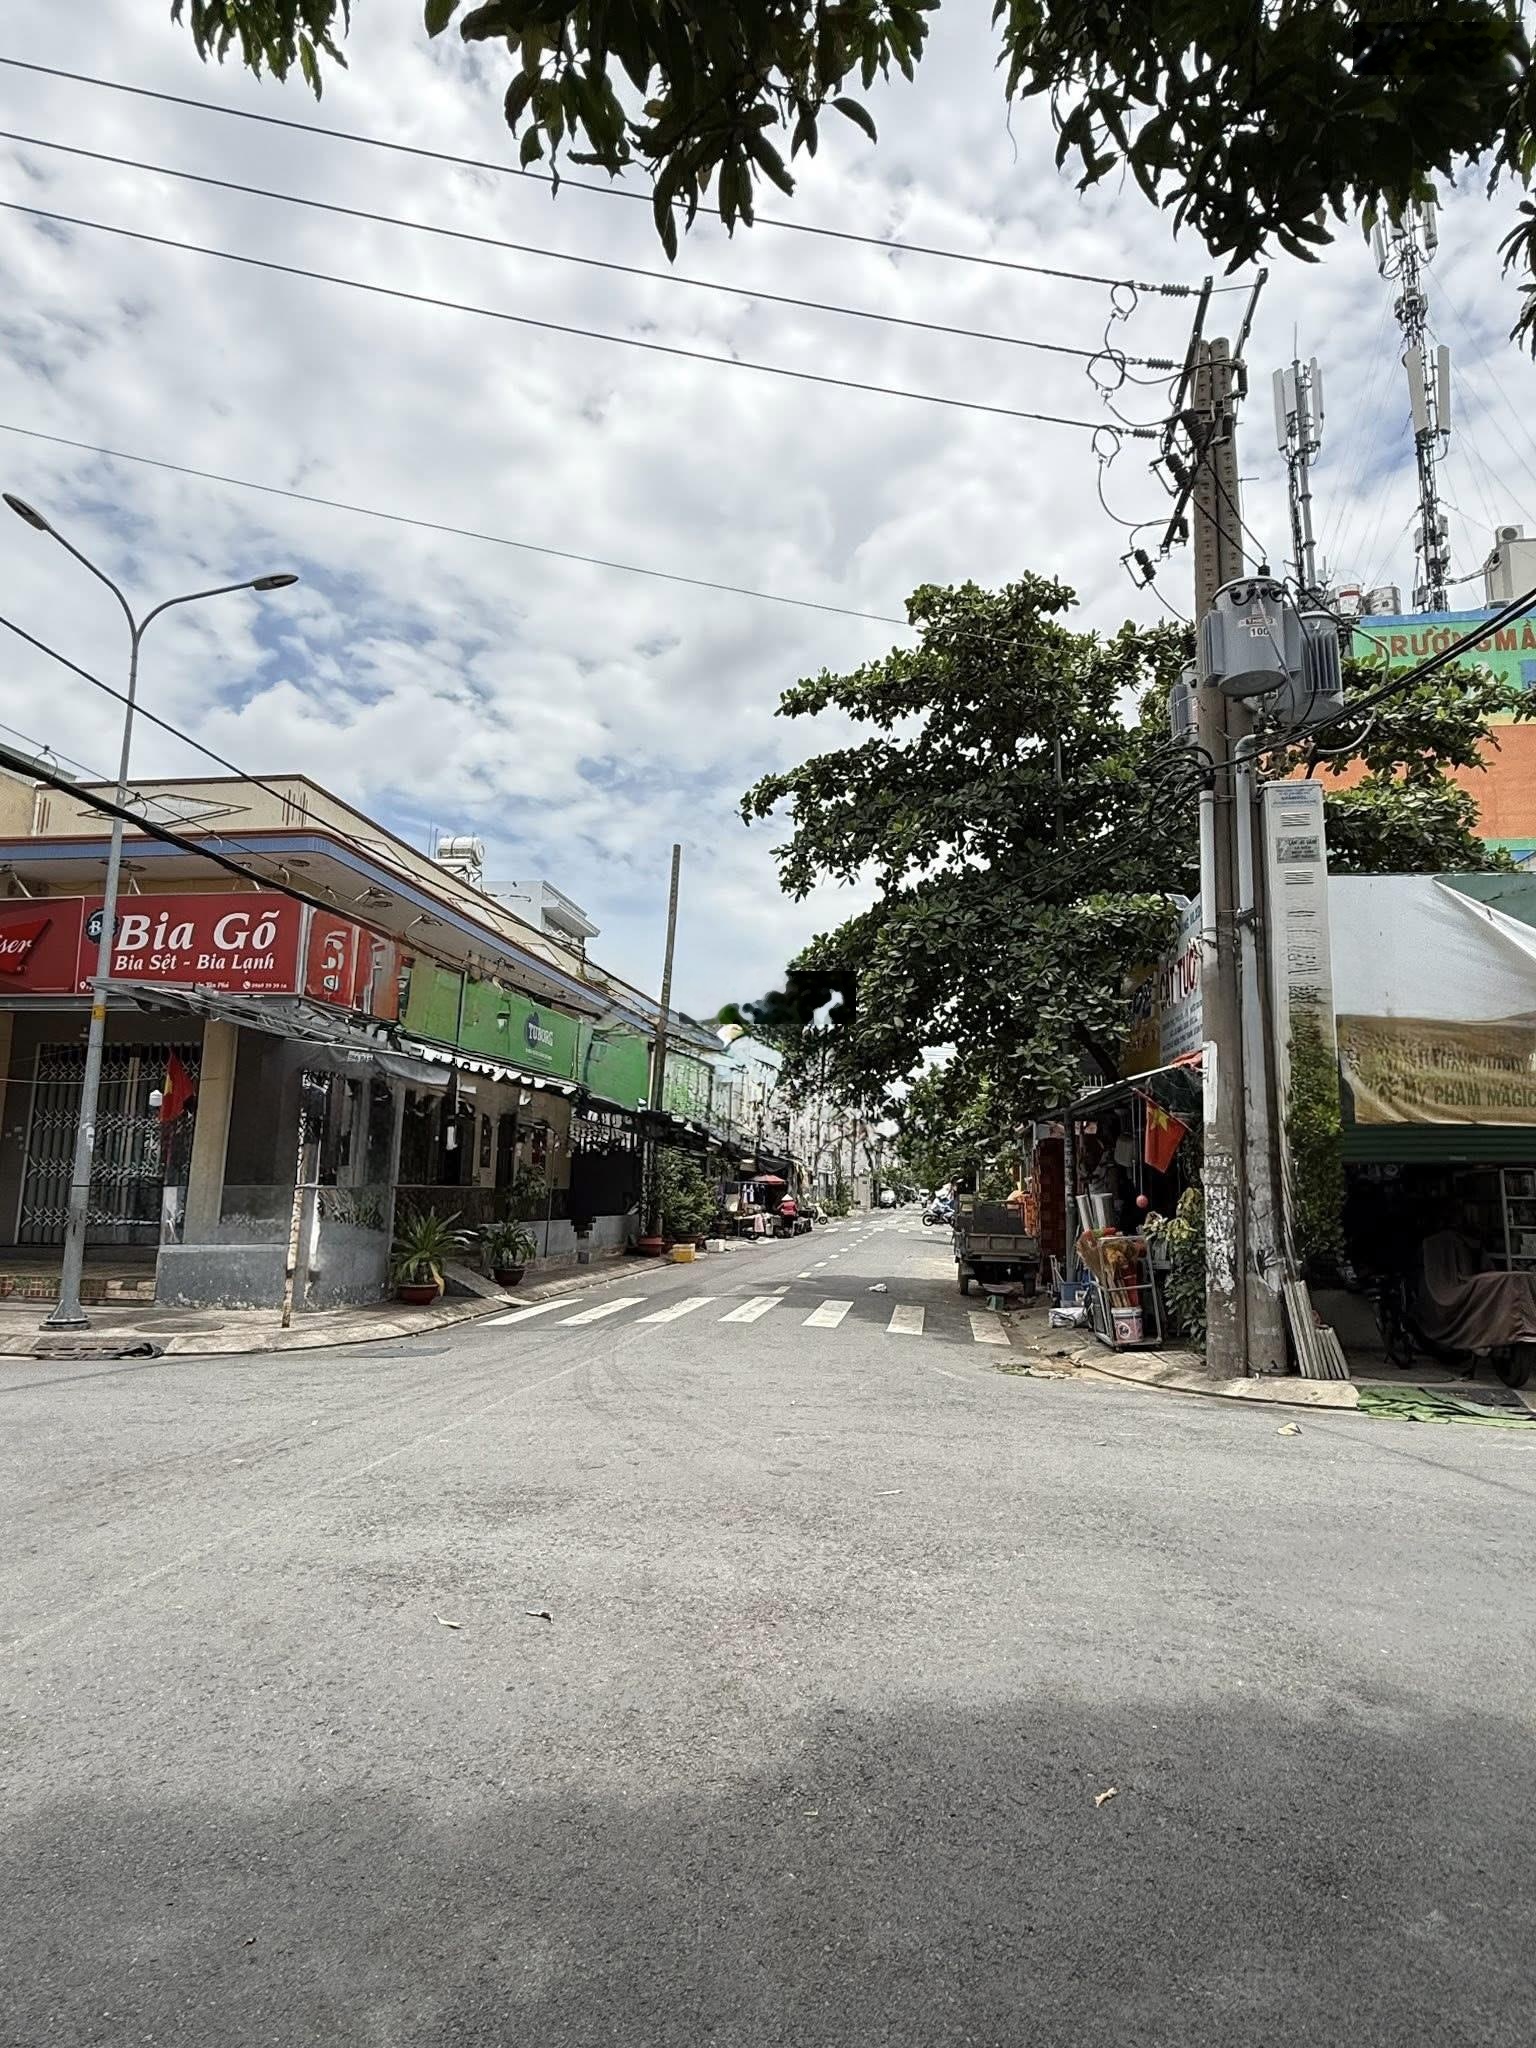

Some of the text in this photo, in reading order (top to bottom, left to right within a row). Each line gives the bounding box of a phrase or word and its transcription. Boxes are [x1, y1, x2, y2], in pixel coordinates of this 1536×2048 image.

[114, 910, 280, 951] Bia Gõ
[115, 955, 143, 971] Bia
[149, 953, 177, 975] Sệt
[197, 953, 225, 970] Bia
[231, 952, 275, 974] Lạnh
